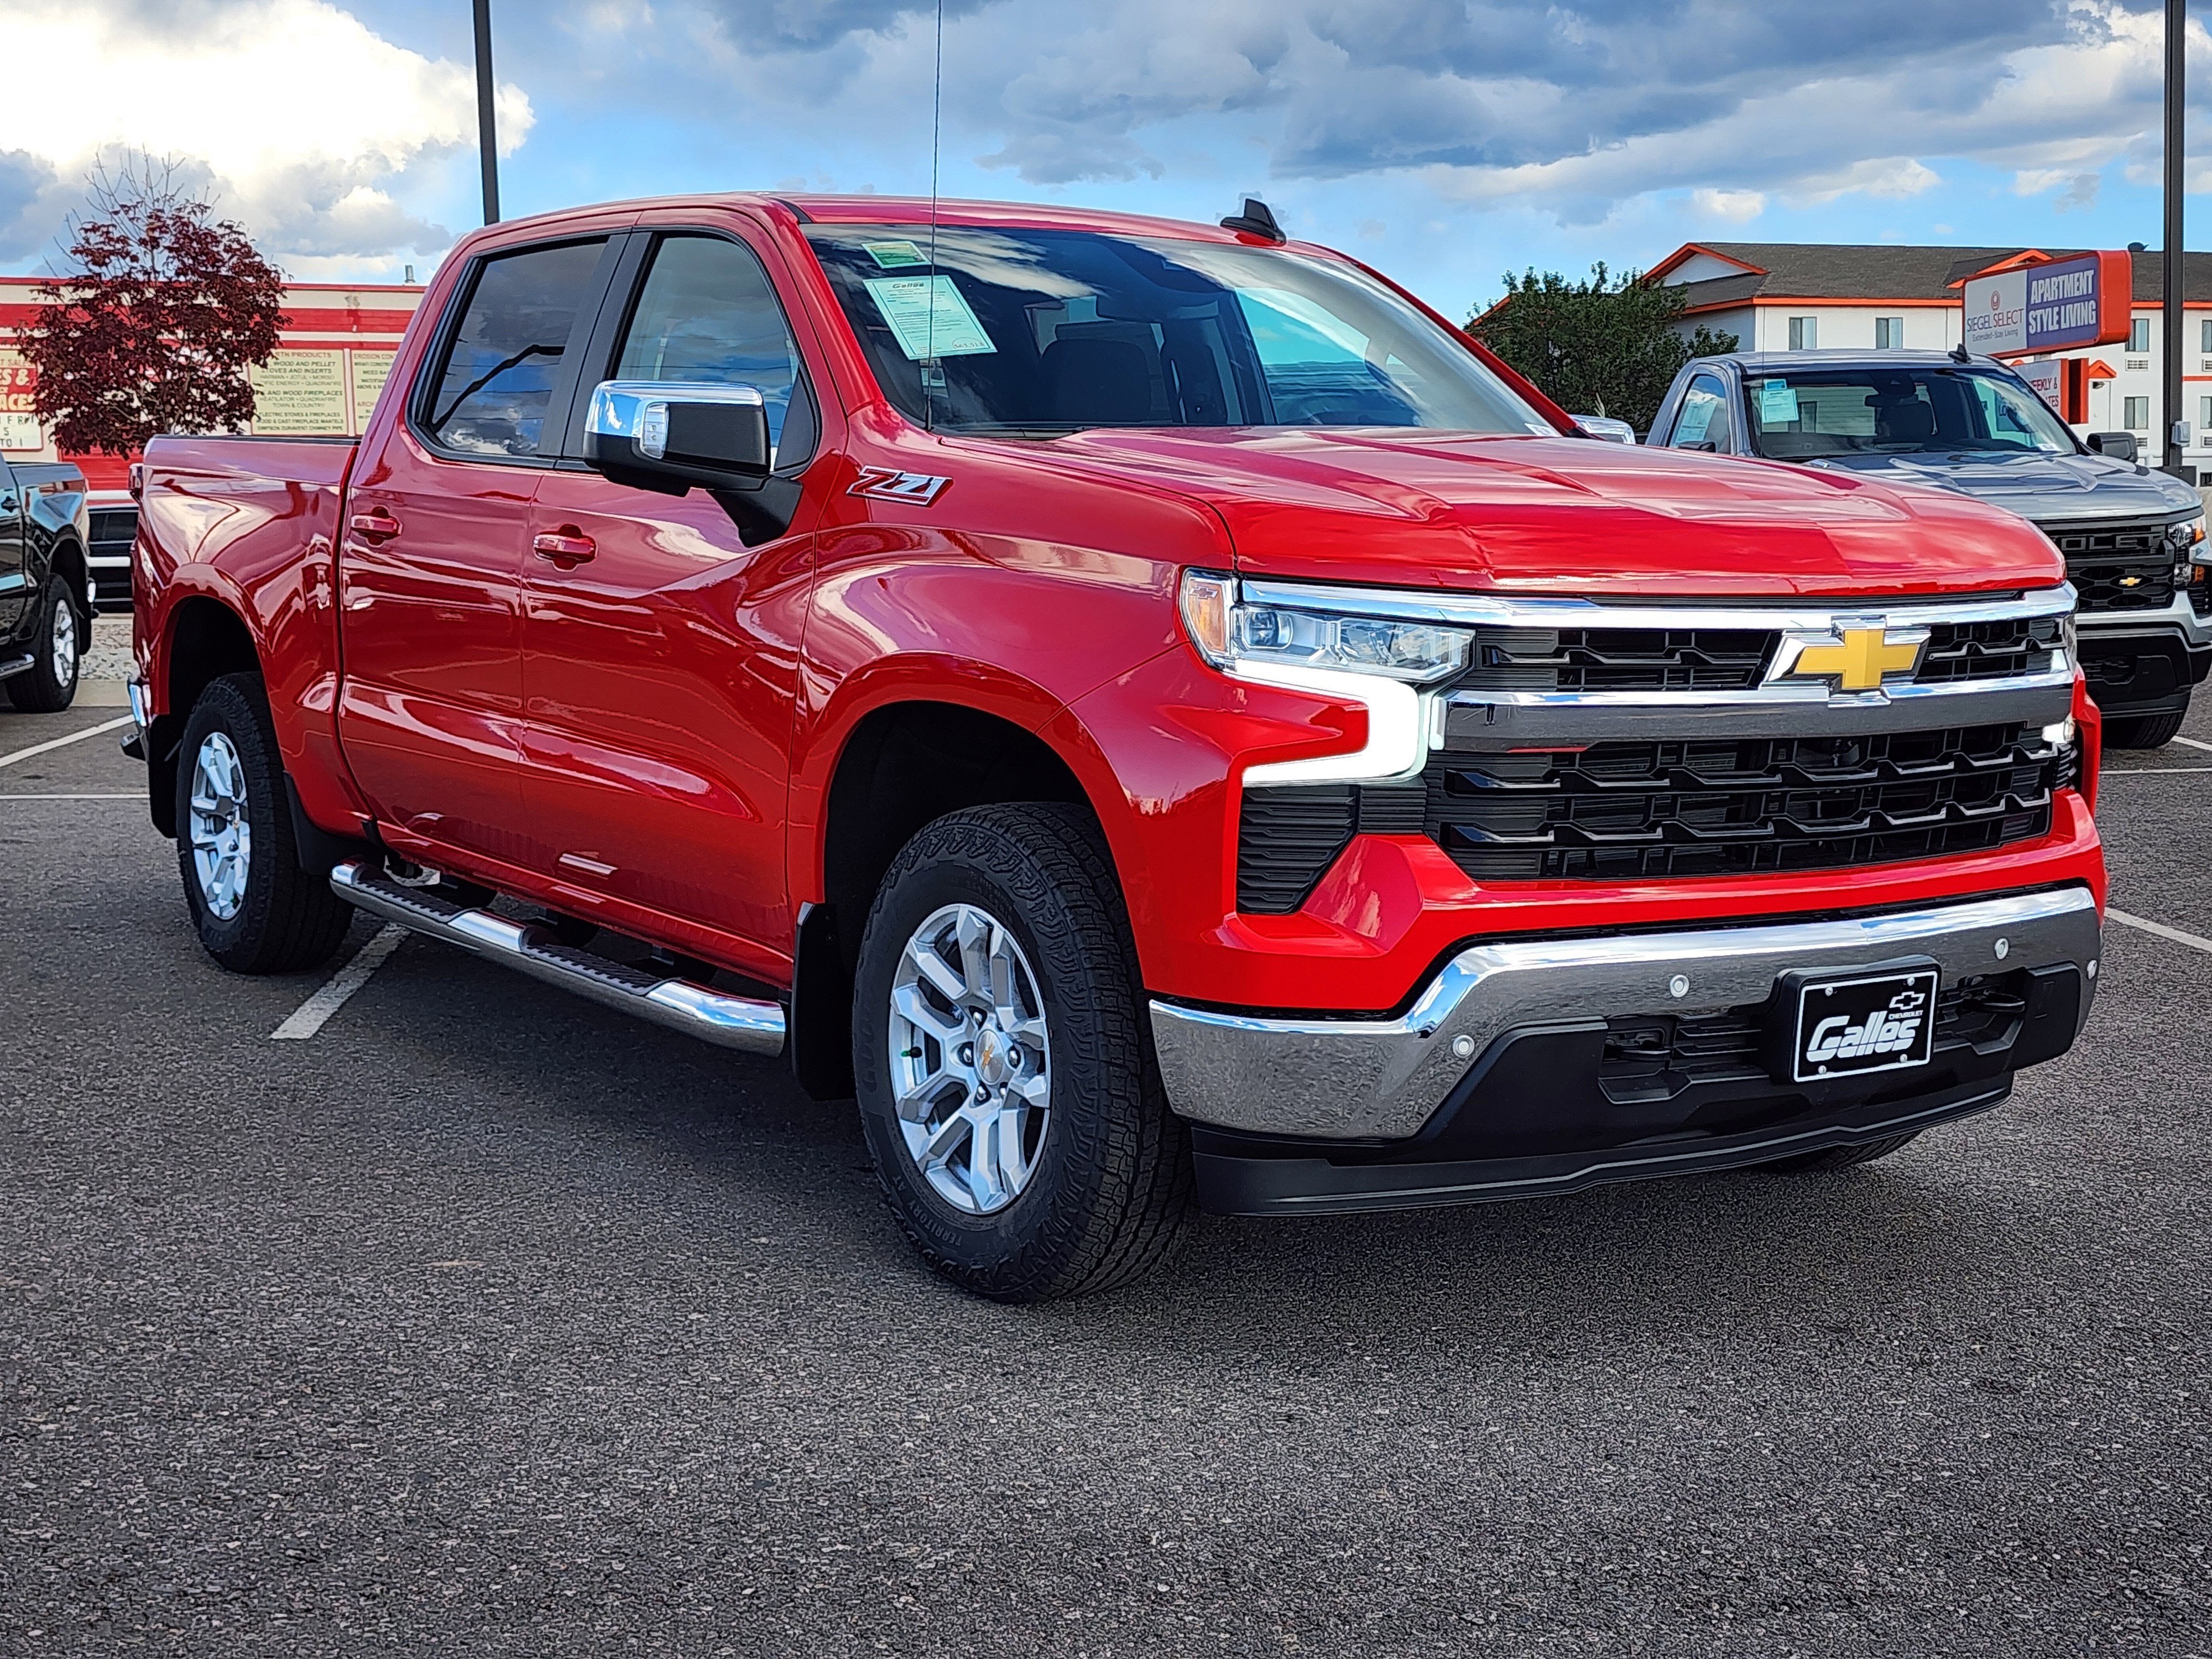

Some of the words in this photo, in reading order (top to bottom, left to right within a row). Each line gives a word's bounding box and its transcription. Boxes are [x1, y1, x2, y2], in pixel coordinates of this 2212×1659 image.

[2030, 269, 2095, 304] APARTMENT
[1967, 315, 1992, 332] SIEGEL
[1993, 308, 2025, 328] SELECT
[2028, 306, 2059, 335] STYLE
[2060, 300, 2097, 329] LIVING
[2005, 329, 2018, 337] Living
[2028, 377, 2052, 392] EEKLY
[2053, 376, 2058, 389] &
[846, 465, 955, 507] Z71
[2059, 531, 2165, 551] OLET
[1888, 1010, 1924, 1020] CHEVROLET
[893, 1176, 907, 1192] AT
[907, 1199, 963, 1246] TERRITORY
